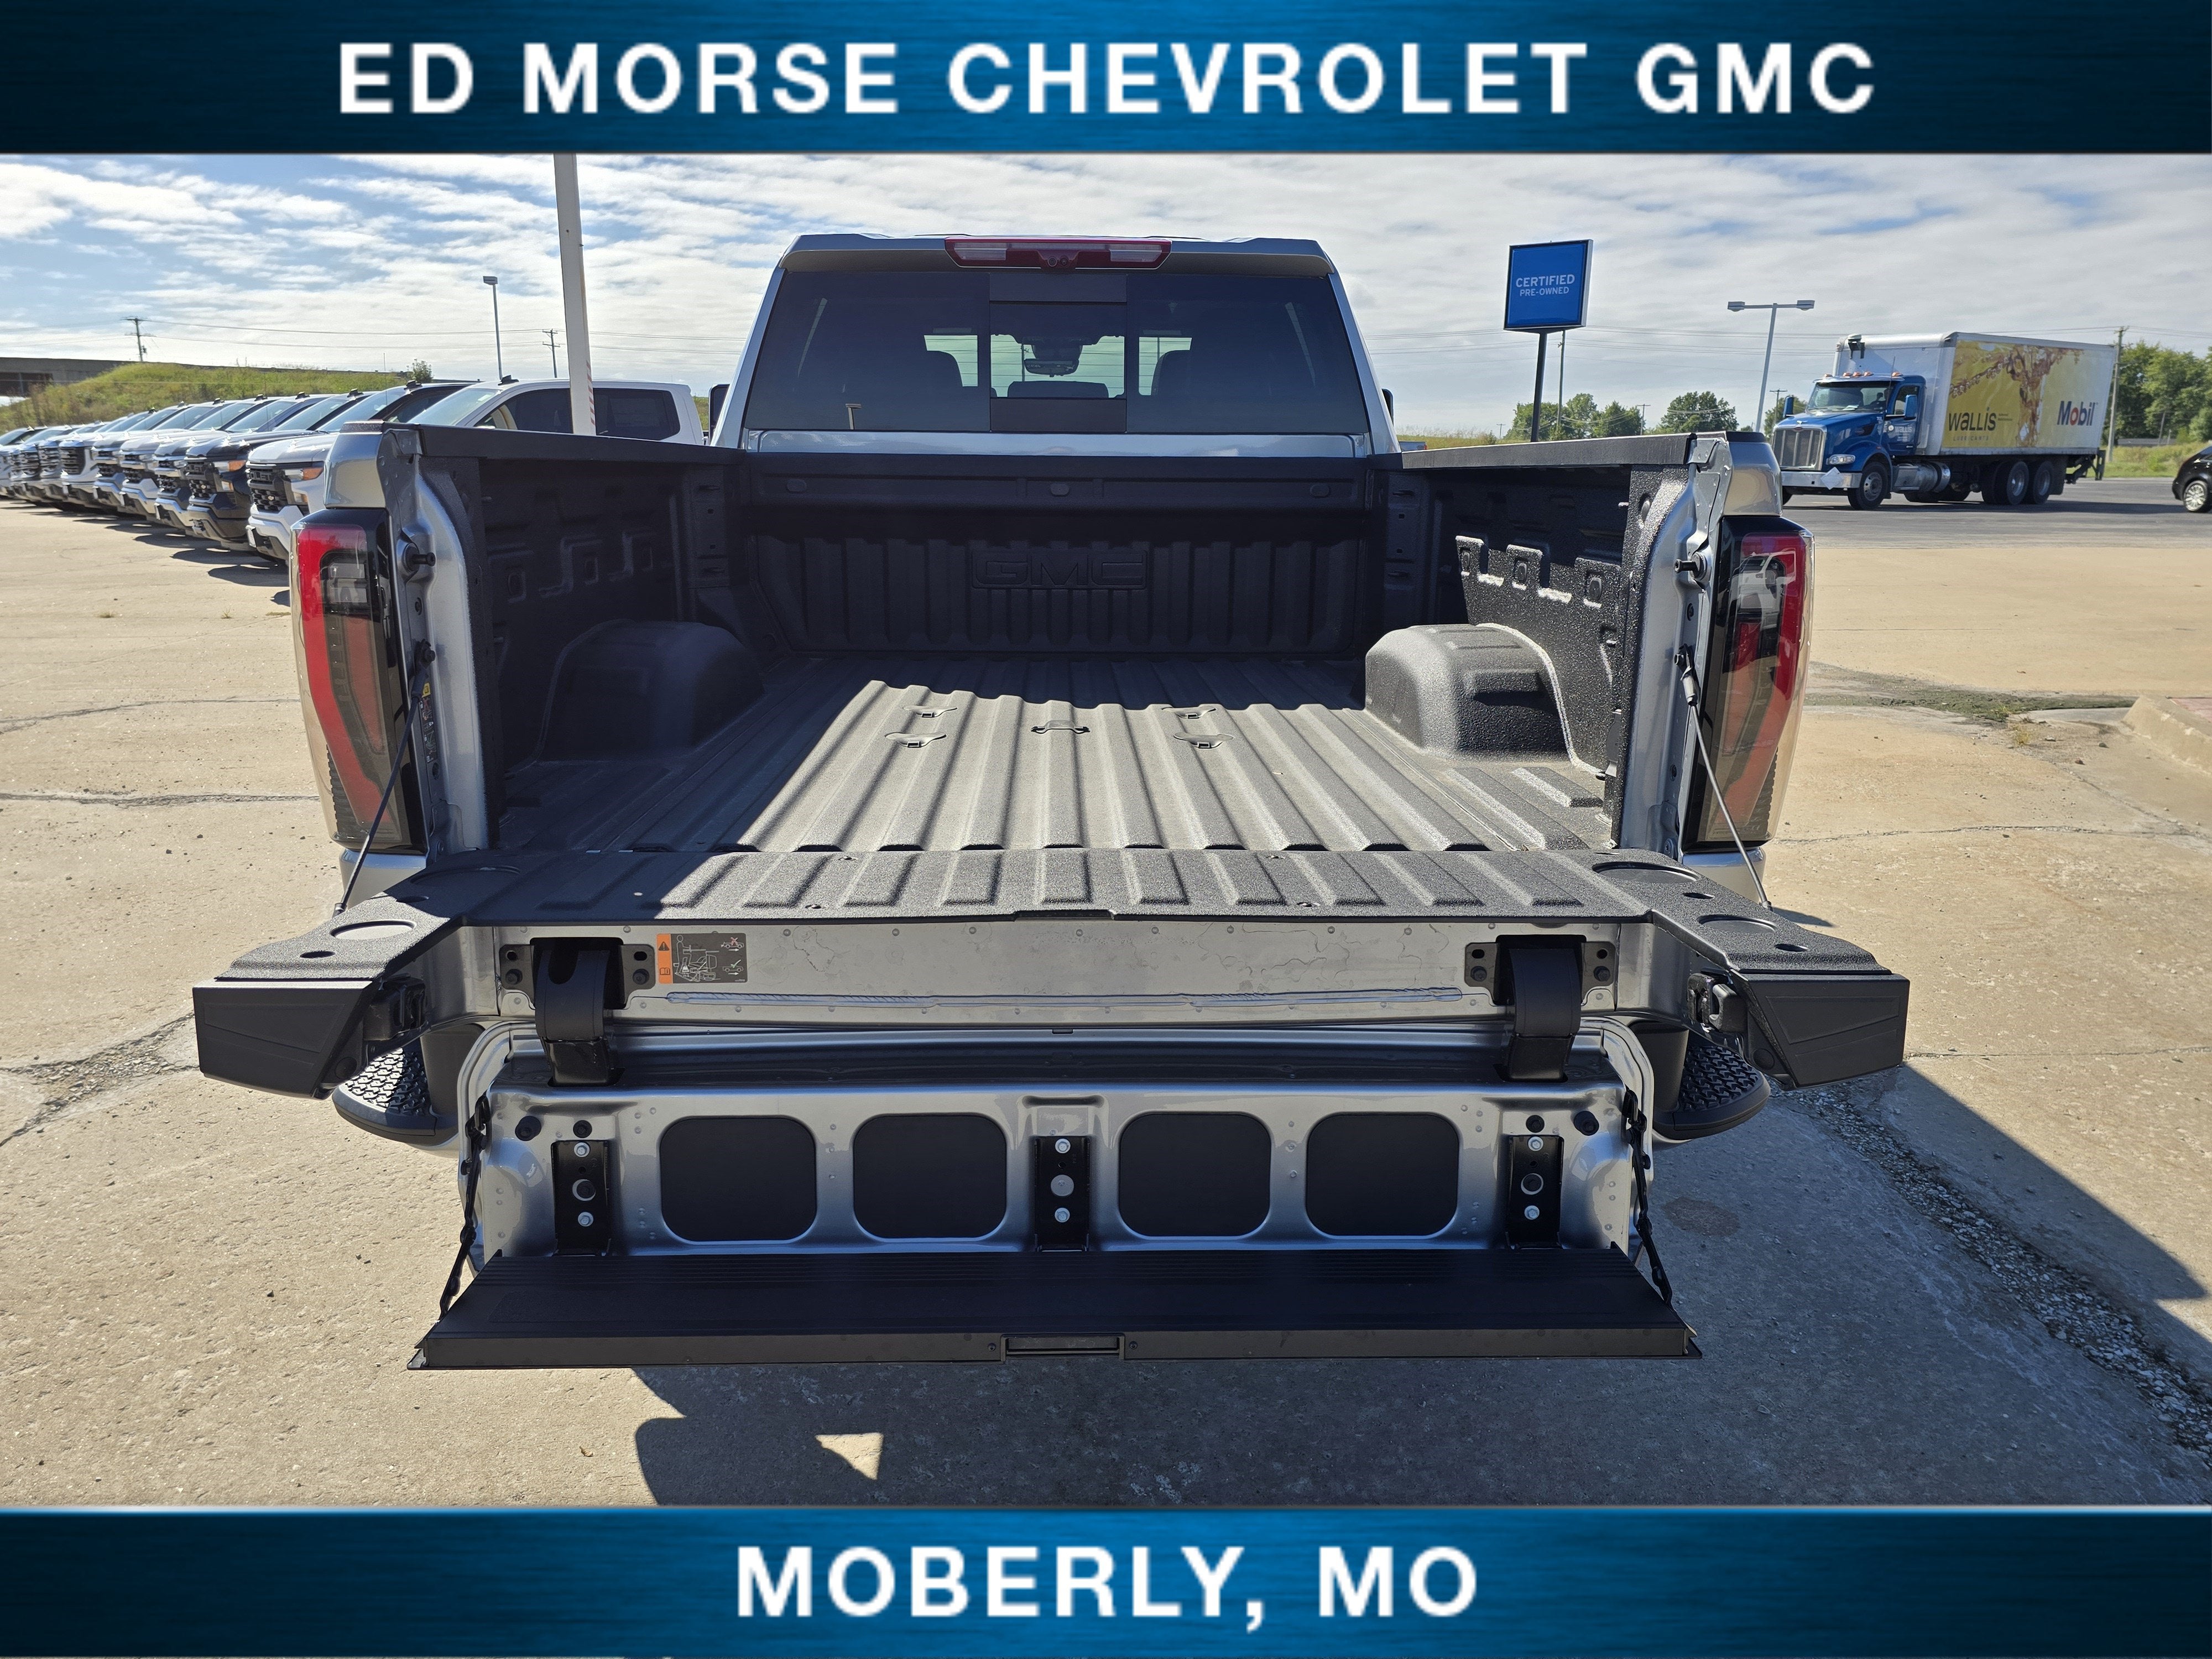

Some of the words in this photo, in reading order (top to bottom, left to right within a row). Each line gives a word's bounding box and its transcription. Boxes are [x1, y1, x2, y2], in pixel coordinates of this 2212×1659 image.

[1516, 274, 1575, 288] CERTIFIED
[1520, 287, 1569, 296] PRE-OWNED
[2057, 400, 2095, 426] Mobil
[975, 552, 1144, 586] GMC
